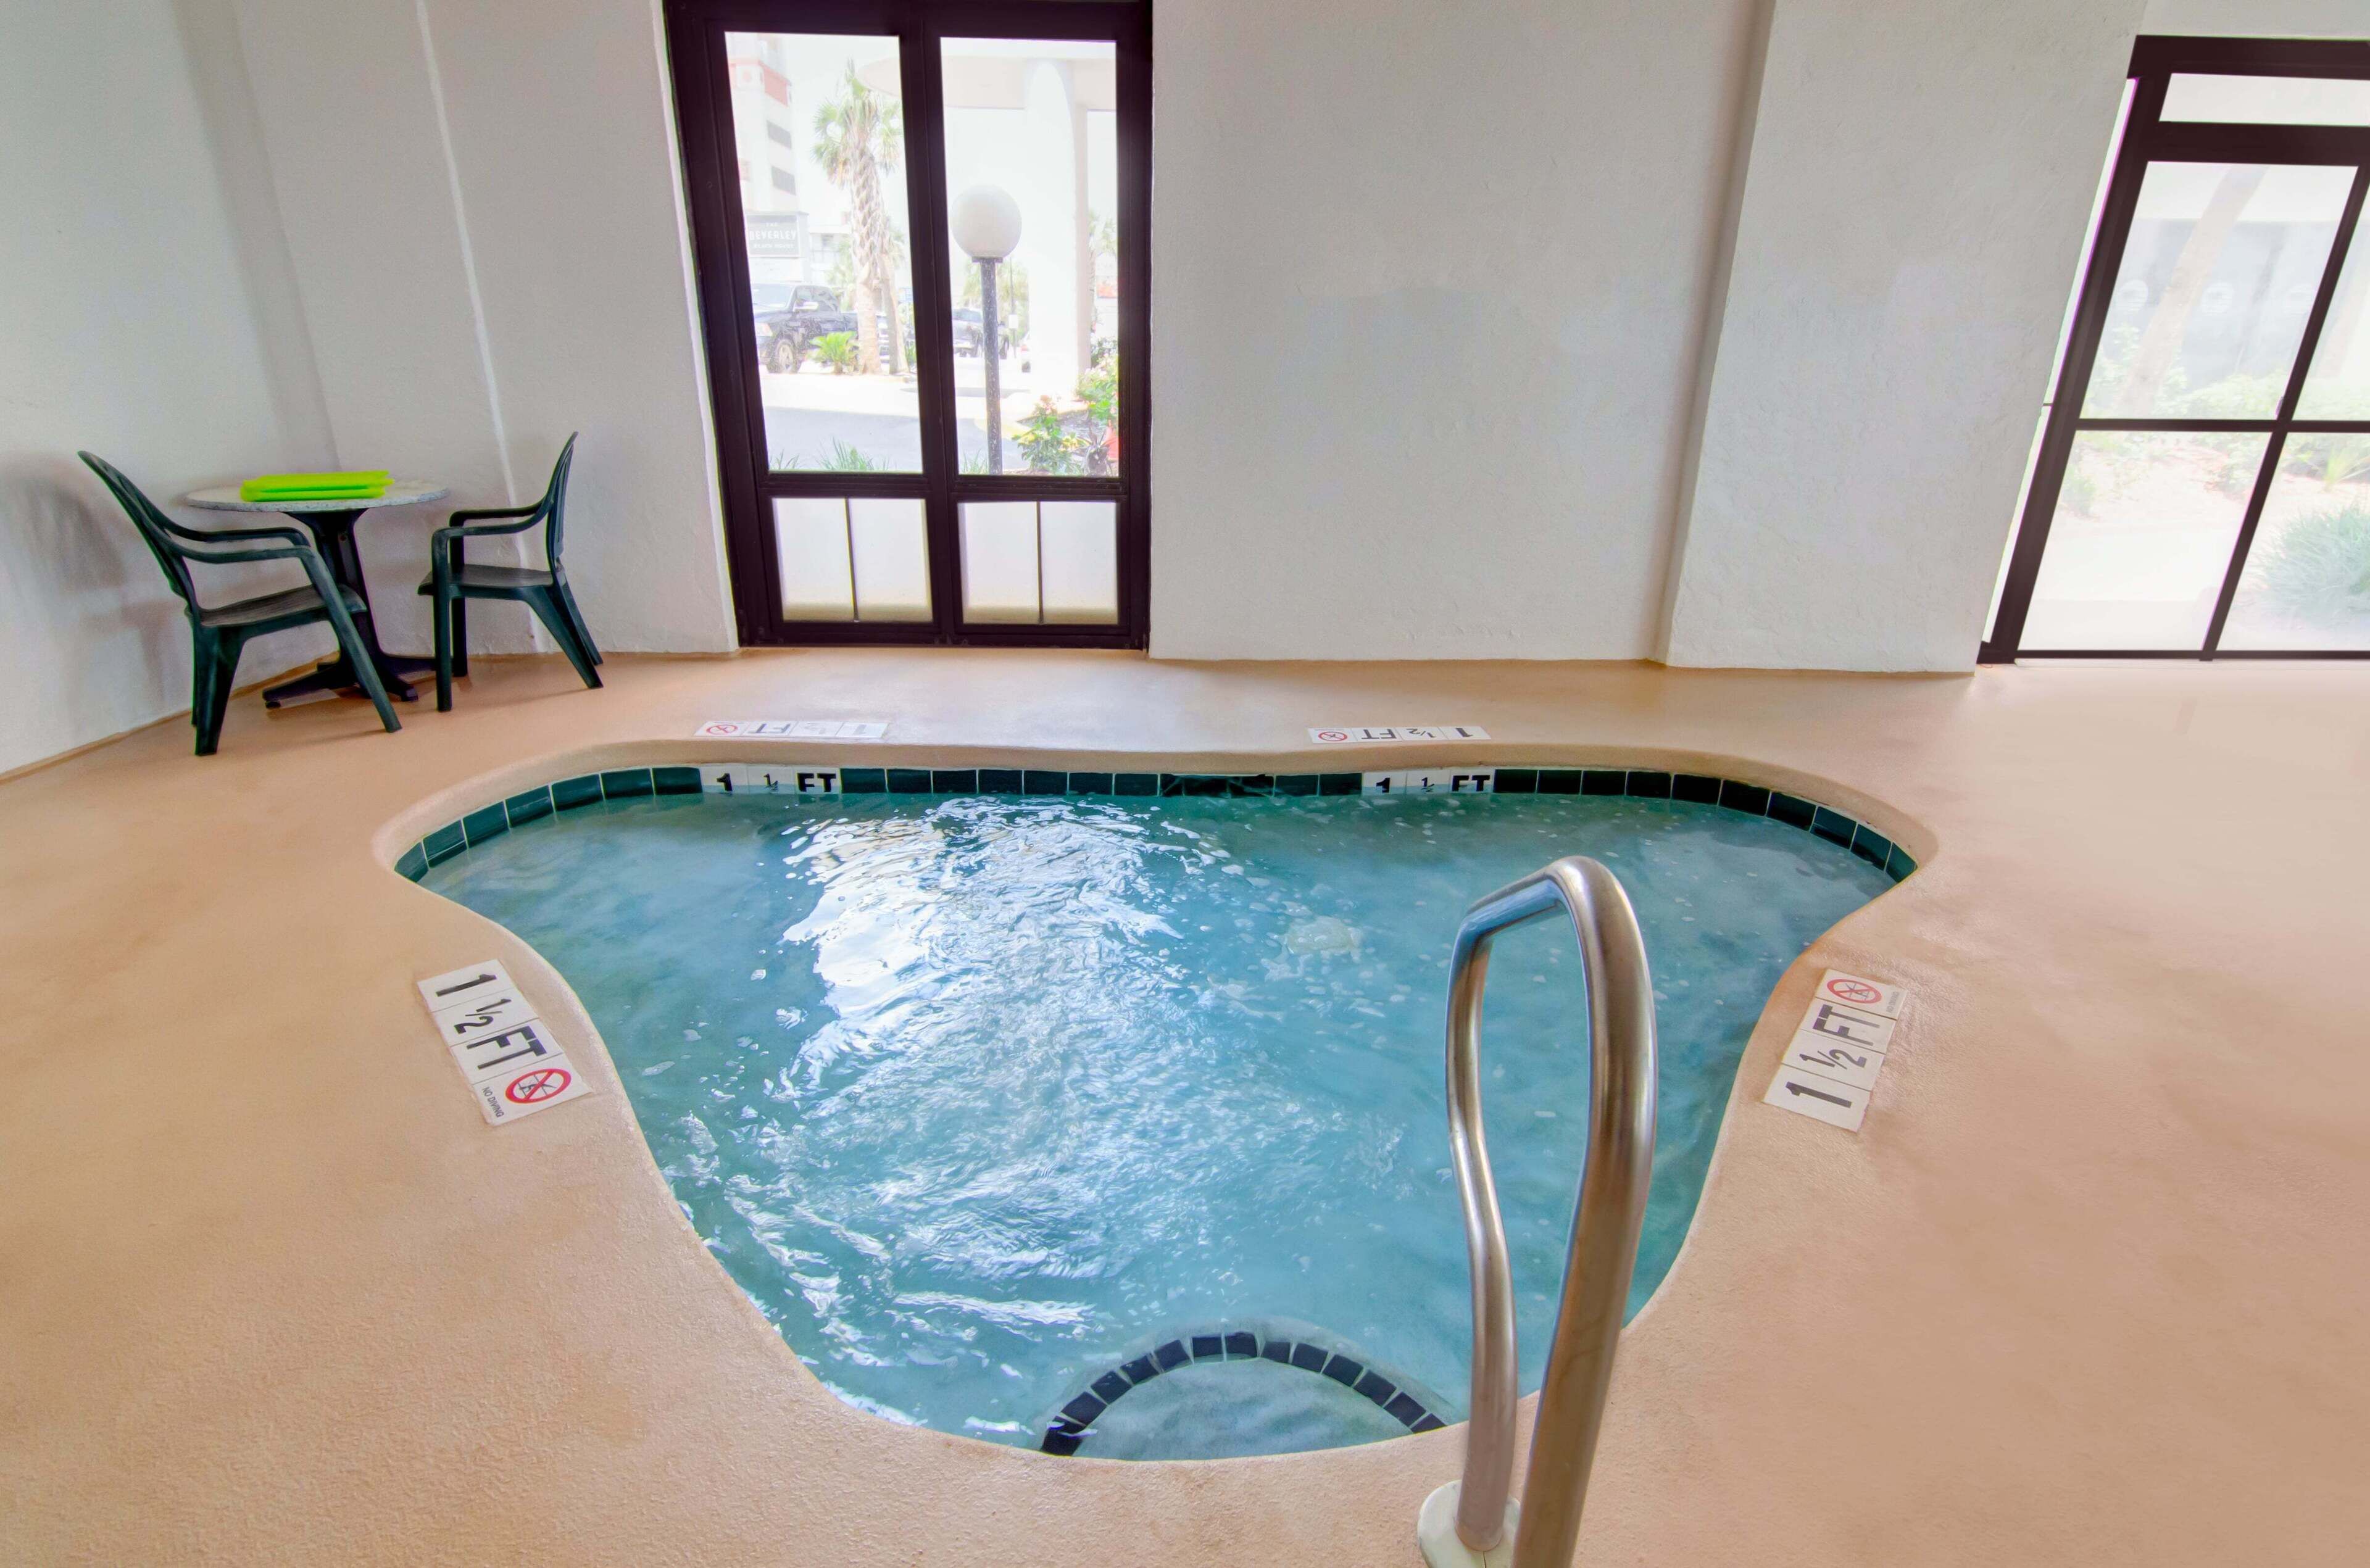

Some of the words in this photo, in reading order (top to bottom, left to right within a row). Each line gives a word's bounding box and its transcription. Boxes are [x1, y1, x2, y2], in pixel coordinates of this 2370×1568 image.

[749, 230, 796, 240] BEVERLEY
[747, 723, 791, 734] FT
[1360, 728, 1397, 740] FT
[1455, 727, 1474, 737] 1
[716, 773, 733, 792] 1
[796, 773, 837, 792] FT
[1376, 777, 1391, 793] 1
[1452, 774, 1491, 792] FT
[435, 973, 497, 997] 1
[466, 1025, 547, 1070] FT
[1813, 1003, 1880, 1047] FT
[481, 1086, 493, 1097] NO
[487, 1096, 505, 1118] DIVING
[1785, 1081, 1852, 1109] 1
